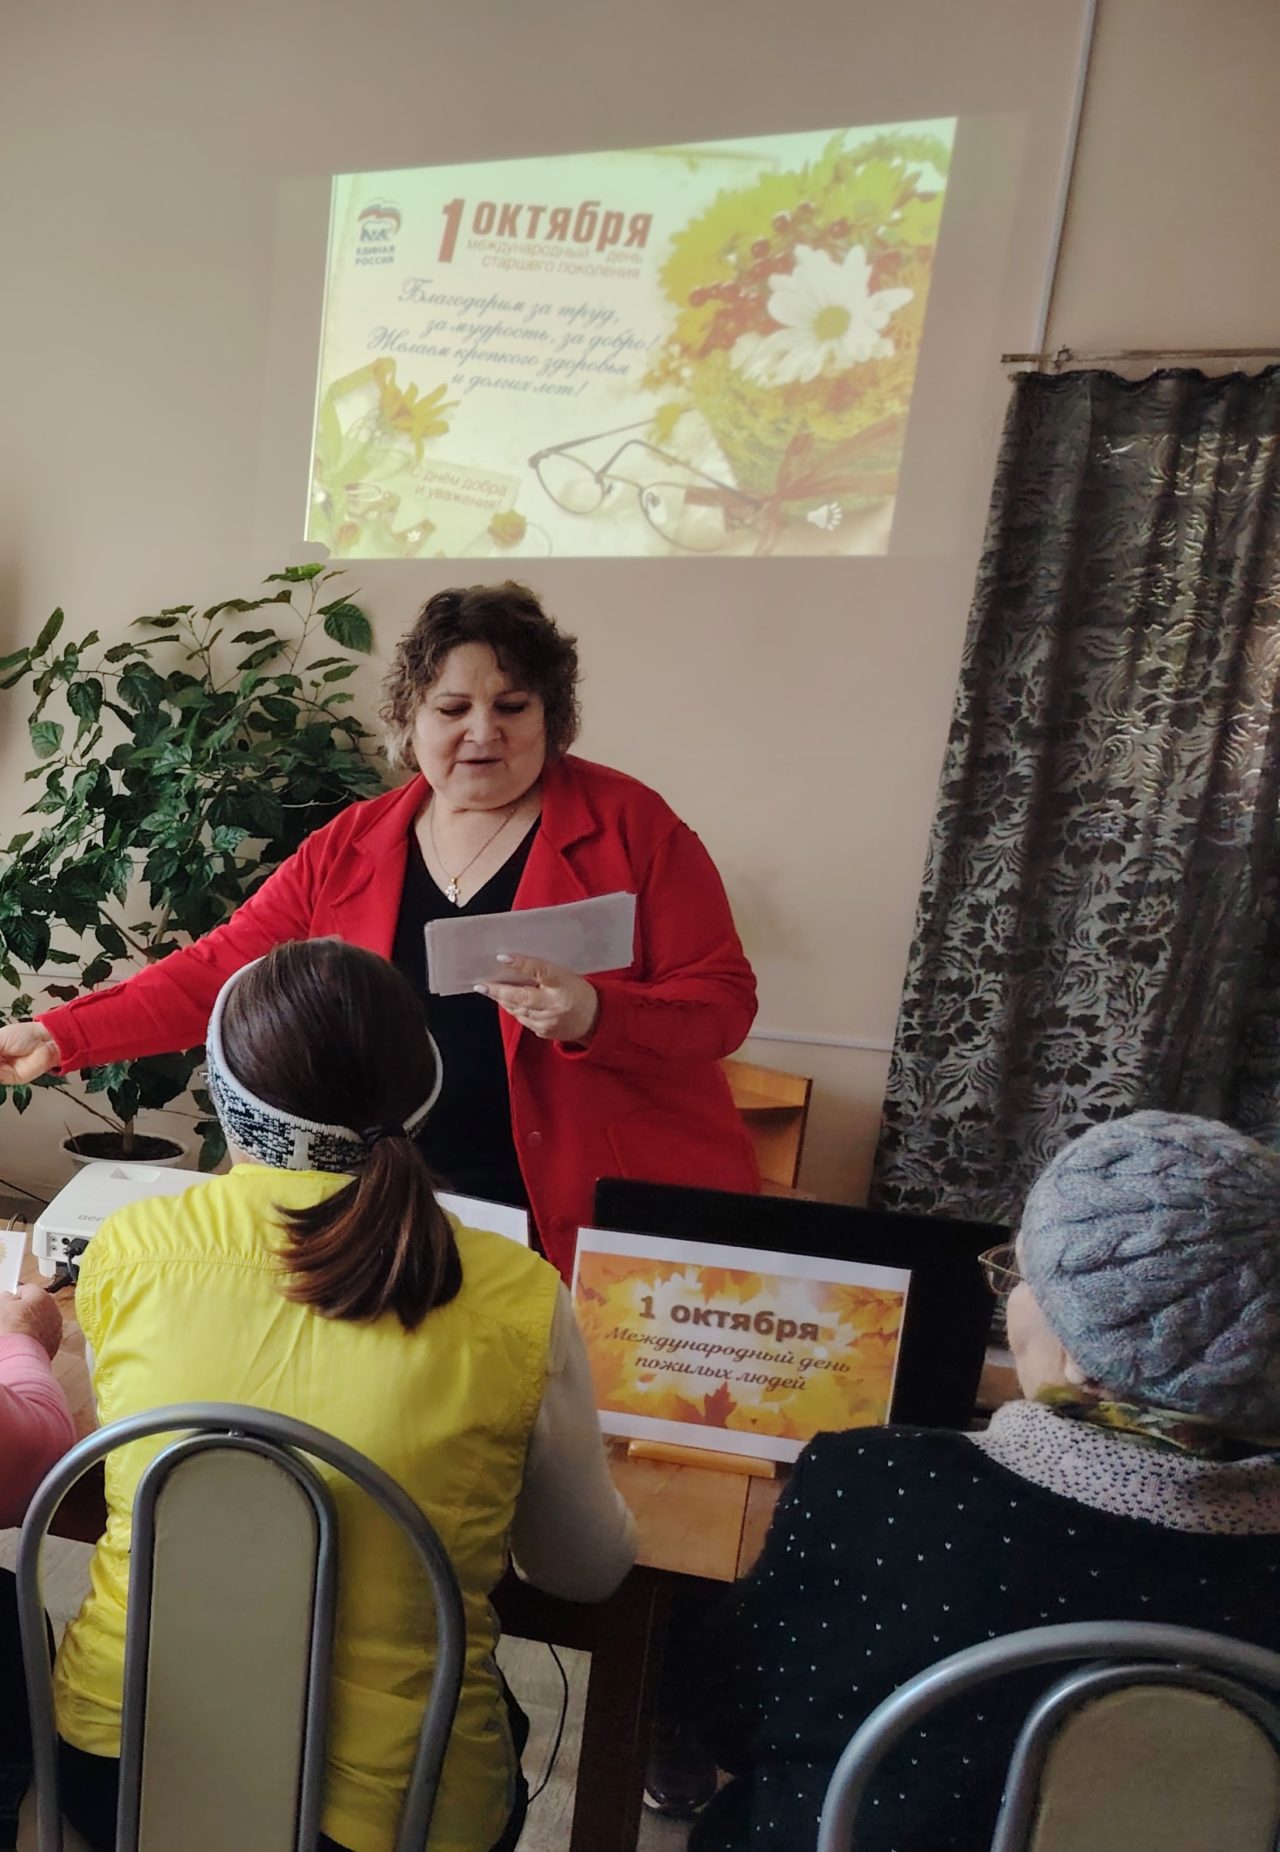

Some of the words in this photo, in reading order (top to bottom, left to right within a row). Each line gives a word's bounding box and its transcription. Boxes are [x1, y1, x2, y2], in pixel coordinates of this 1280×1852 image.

[355, 244, 396, 257] ЕДИНАЯ
[438, 198, 466, 263] 1
[471, 200, 653, 252] октября
[354, 256, 395, 266] РОССИЯ
[398, 276, 523, 316] Благодарим
[524, 302, 552, 322] за
[420, 317, 447, 337] за
[561, 331, 585, 351] за
[638, 1296, 656, 1320] 1
[670, 1303, 819, 1343] октября
[605, 1326, 794, 1366] Международный
[799, 1353, 851, 1374] день
[634, 1355, 733, 1381] пожилых
[735, 1369, 807, 1392] людей
